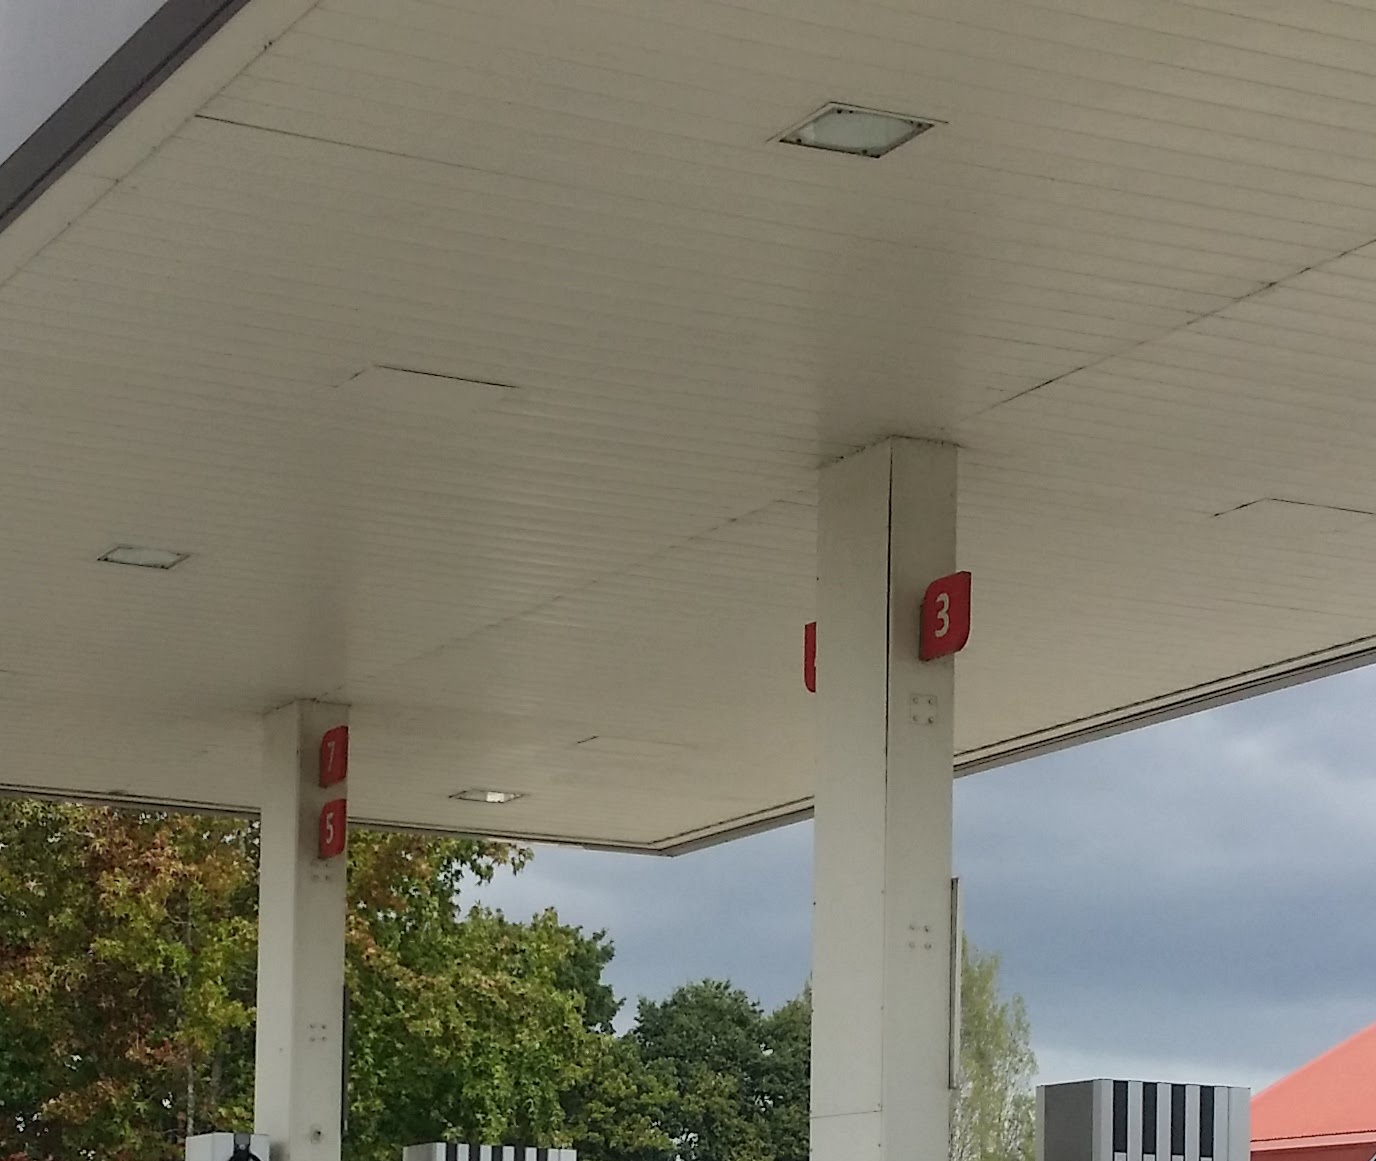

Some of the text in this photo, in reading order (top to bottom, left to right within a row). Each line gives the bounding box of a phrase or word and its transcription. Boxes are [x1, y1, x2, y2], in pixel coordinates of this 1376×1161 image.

[933, 592, 951, 639] 3
[326, 740, 336, 774] 7
[325, 812, 335, 845] 5
